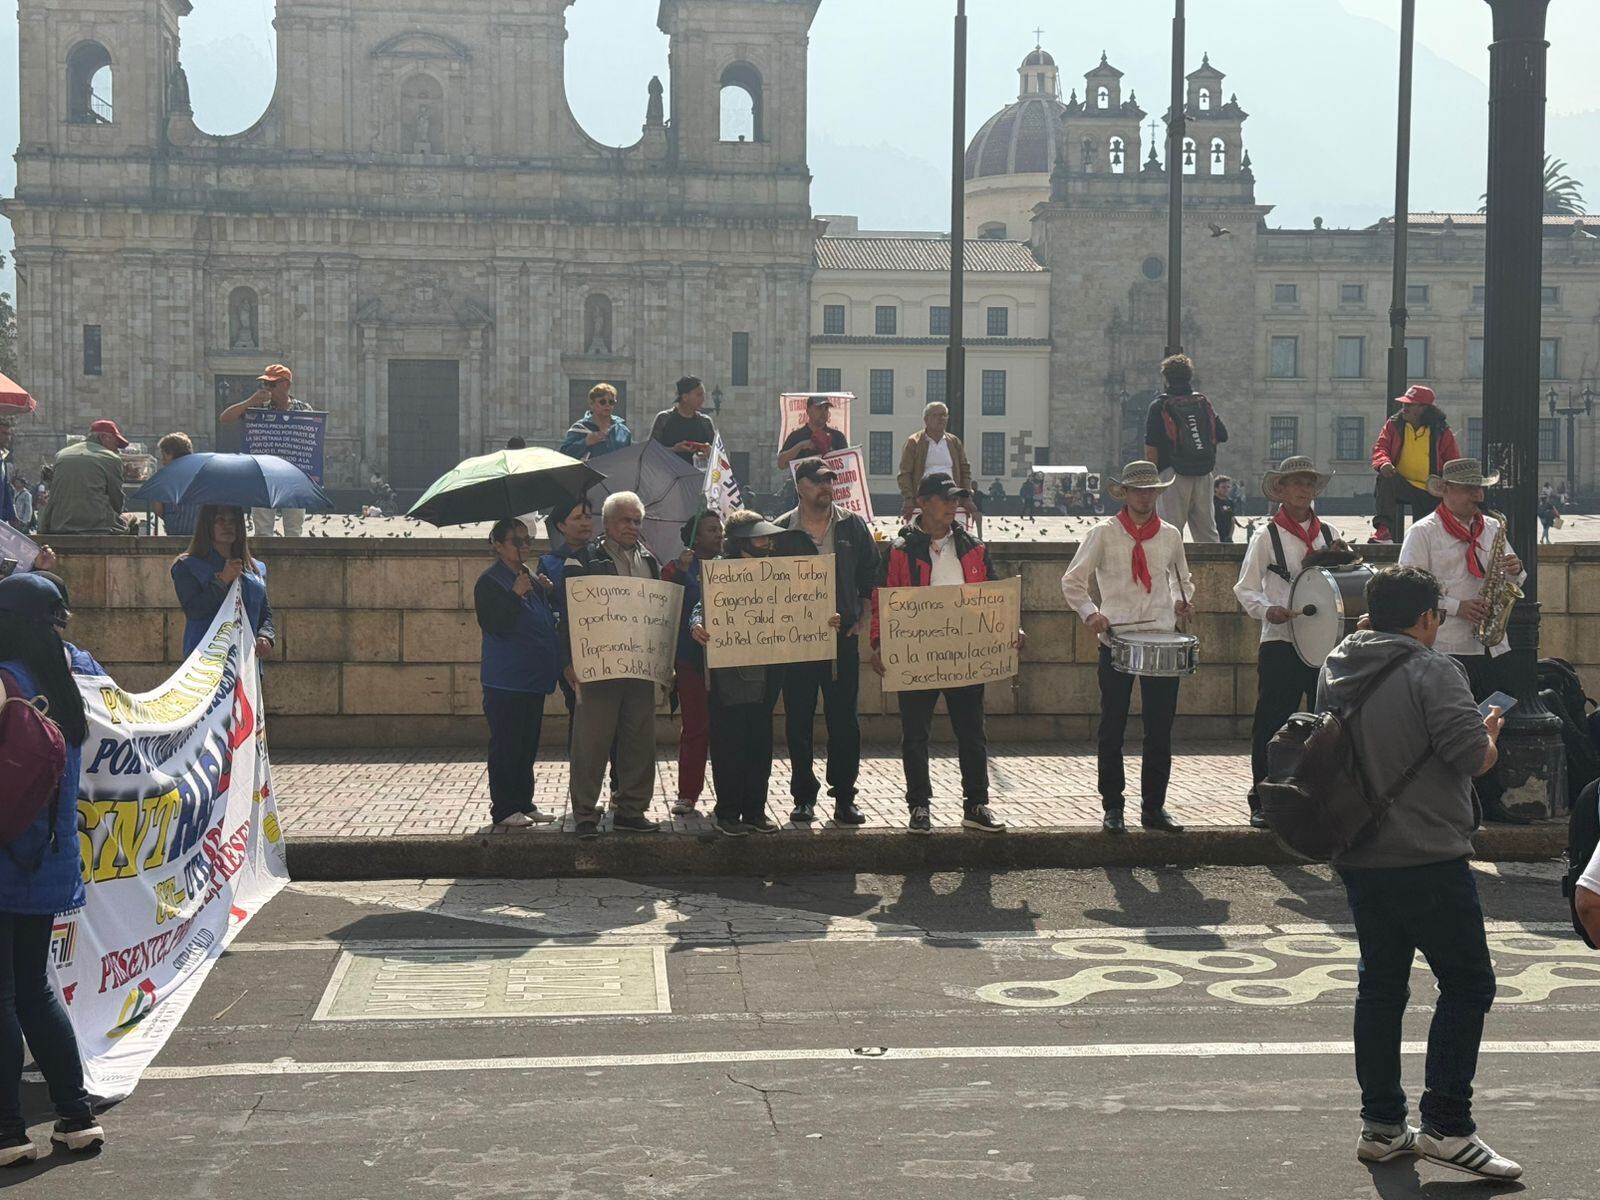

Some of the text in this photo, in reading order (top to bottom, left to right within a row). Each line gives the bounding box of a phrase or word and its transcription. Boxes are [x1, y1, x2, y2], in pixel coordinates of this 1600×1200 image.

[292, 430, 308, 438] PARTE
[704, 560, 828, 586] Veeduría Diana Turbay
[571, 580, 630, 606] Exigimos
[649, 592, 668, 607] pago
[766, 586, 778, 604] el
[784, 586, 829, 604] derecho
[888, 588, 1005, 618] Exigimos Justicia
[578, 607, 628, 631] oportuno
[712, 606, 813, 626] a la Salud en la
[978, 610, 1005, 634] No
[756, 630, 786, 646] Centro
[788, 626, 829, 644] Oriente
[889, 653, 900, 665] a
[907, 644, 920, 664] la
[582, 666, 596, 679] en
[602, 658, 612, 676] la
[980, 656, 1012, 678] Salud
[365, 954, 494, 1012] BOLIVAR
[505, 958, 621, 1002] PLAZA
